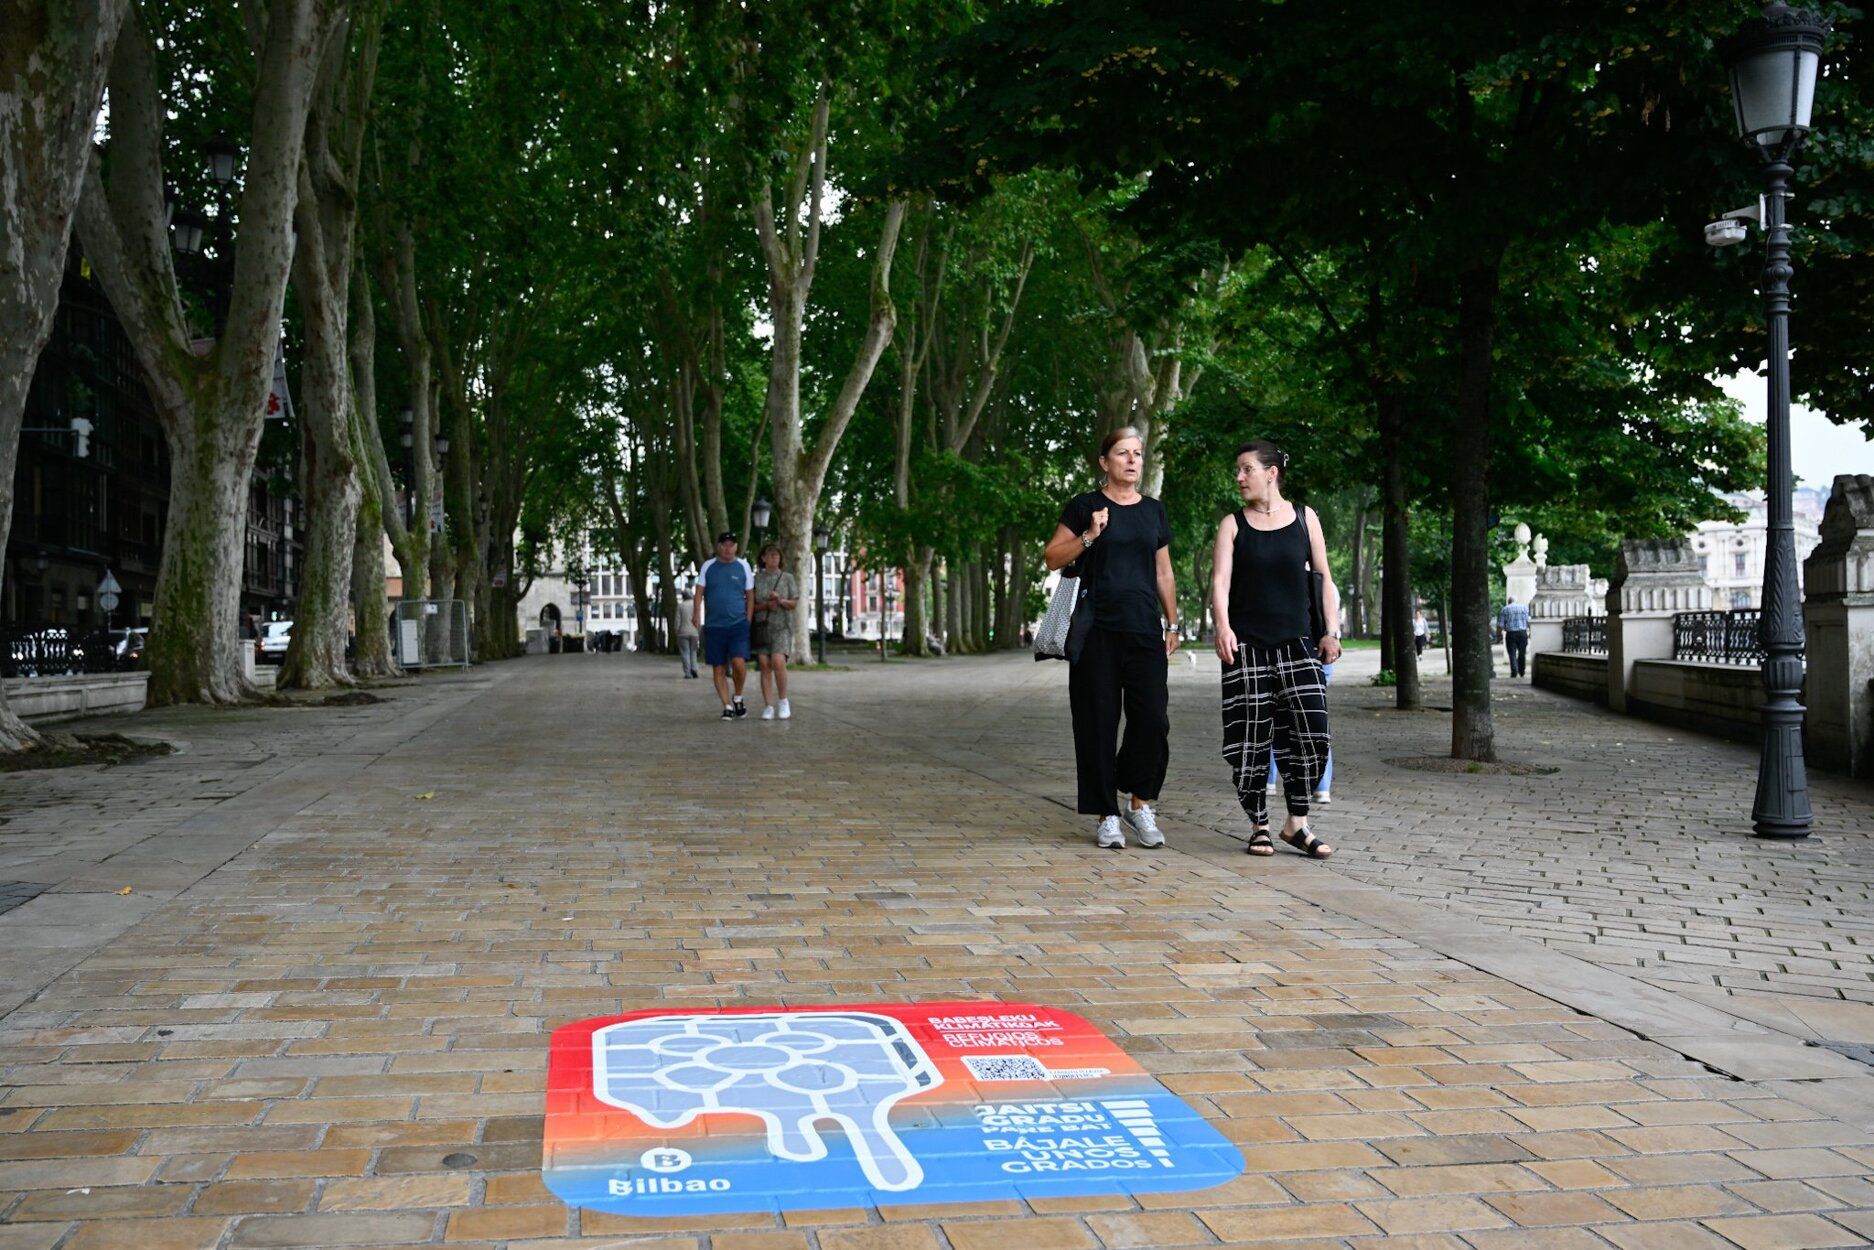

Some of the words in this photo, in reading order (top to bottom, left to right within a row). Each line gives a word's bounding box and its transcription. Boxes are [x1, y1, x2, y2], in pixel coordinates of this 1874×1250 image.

[928, 1014, 1037, 1024] BABESLEKU
[933, 1020, 1060, 1030] KLIMATIKOAK
[942, 1031, 1040, 1041] REFUGIOS
[975, 1102, 1097, 1117] JAITSI
[982, 1114, 1105, 1126] GRADU
[1060, 1123, 1112, 1132] BAT
[983, 1135, 1127, 1151] BÁJALE
[1021, 1147, 1140, 1161] UNOS
[1001, 1159, 1152, 1173] GRADOS
[608, 1177, 731, 1196] Bilbao
